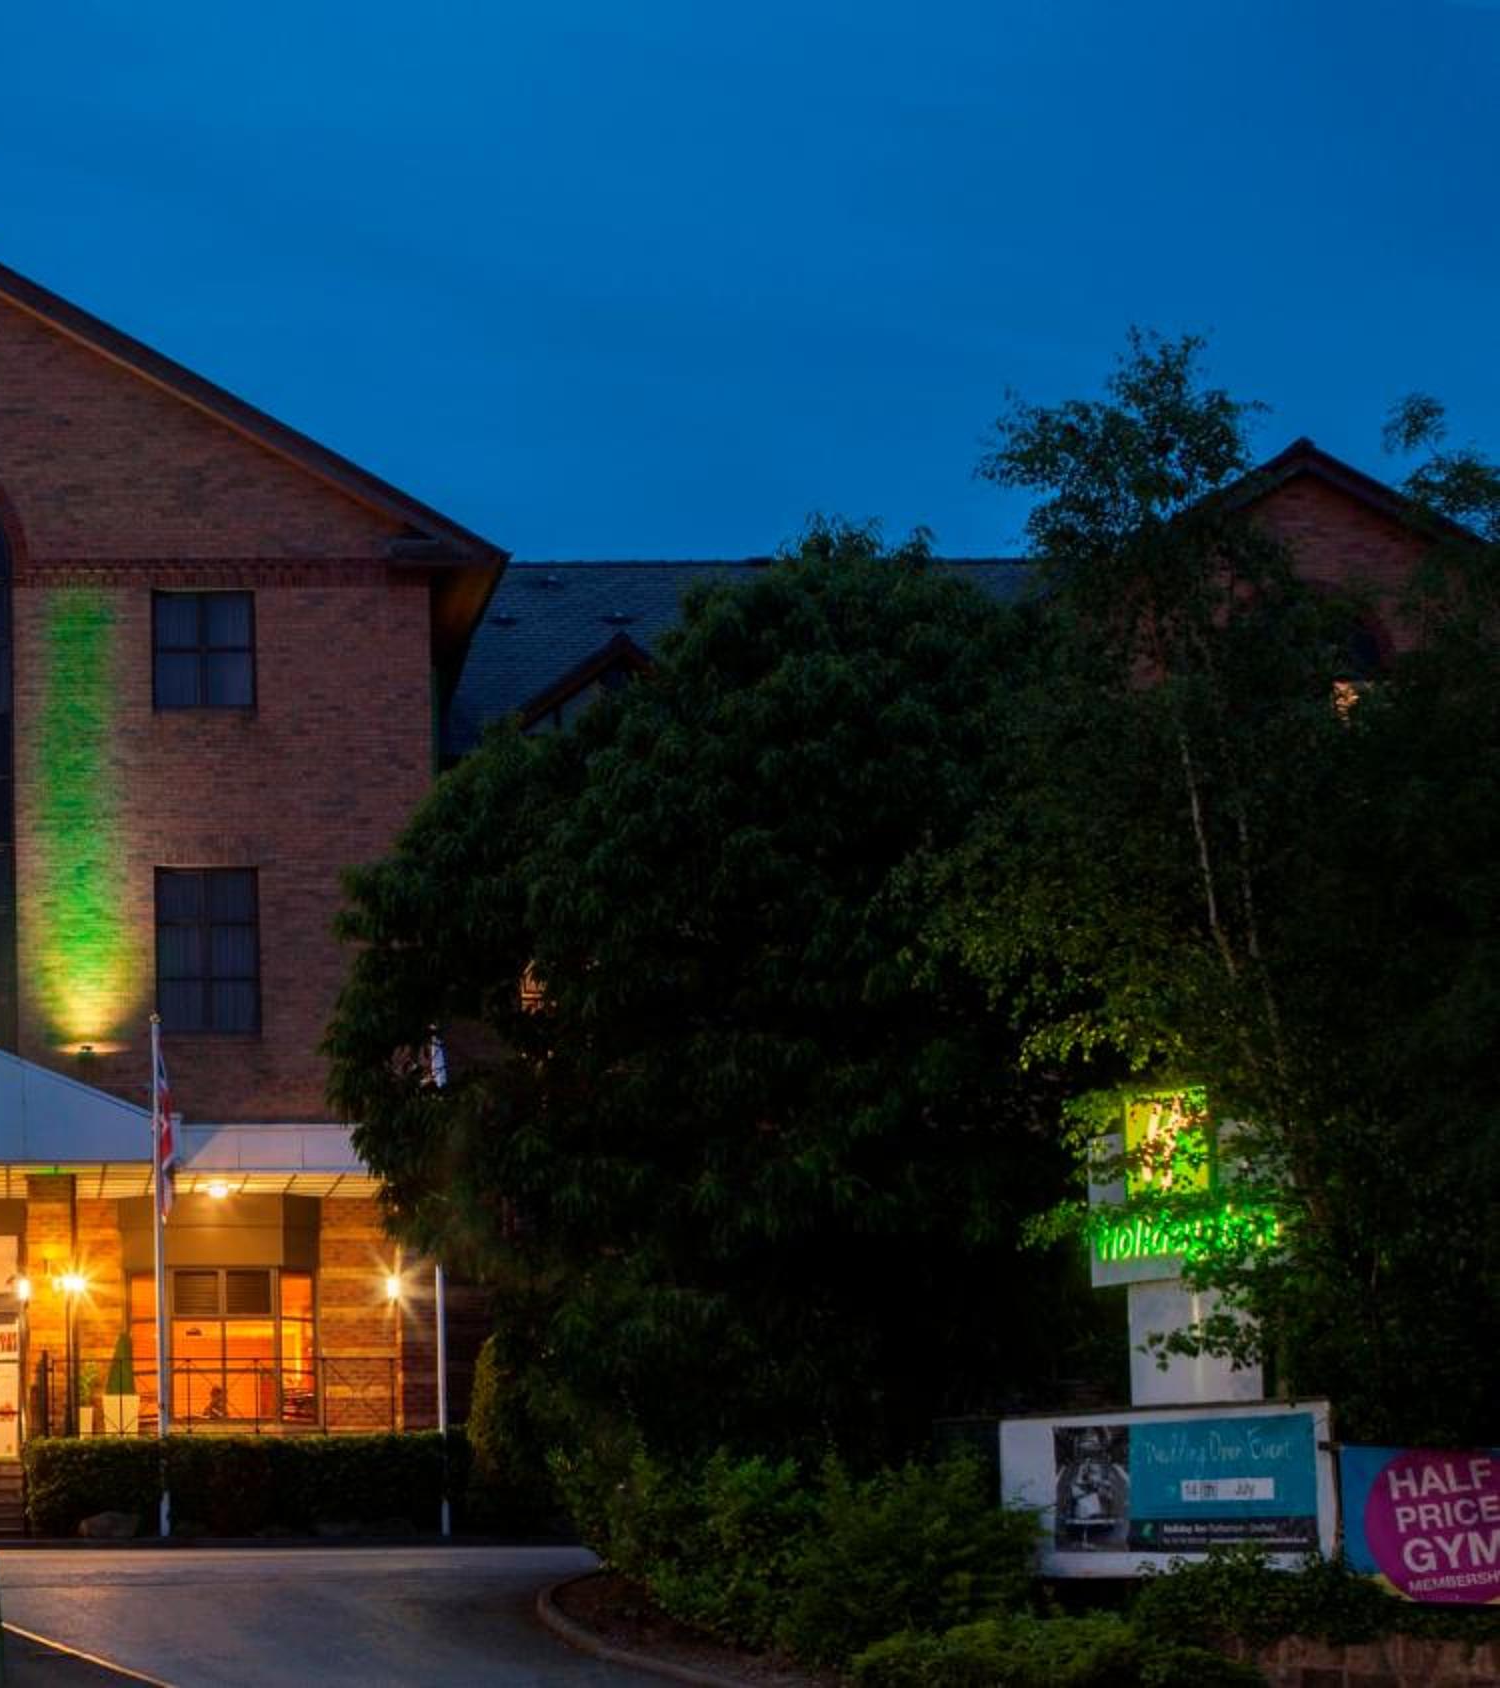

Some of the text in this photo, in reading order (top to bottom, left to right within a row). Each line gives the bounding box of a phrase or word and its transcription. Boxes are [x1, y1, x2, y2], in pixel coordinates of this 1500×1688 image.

[1388, 1459, 1491, 1501] HALF
[1395, 1495, 1500, 1533] PRICE
[1403, 1529, 1500, 1573] GYM
